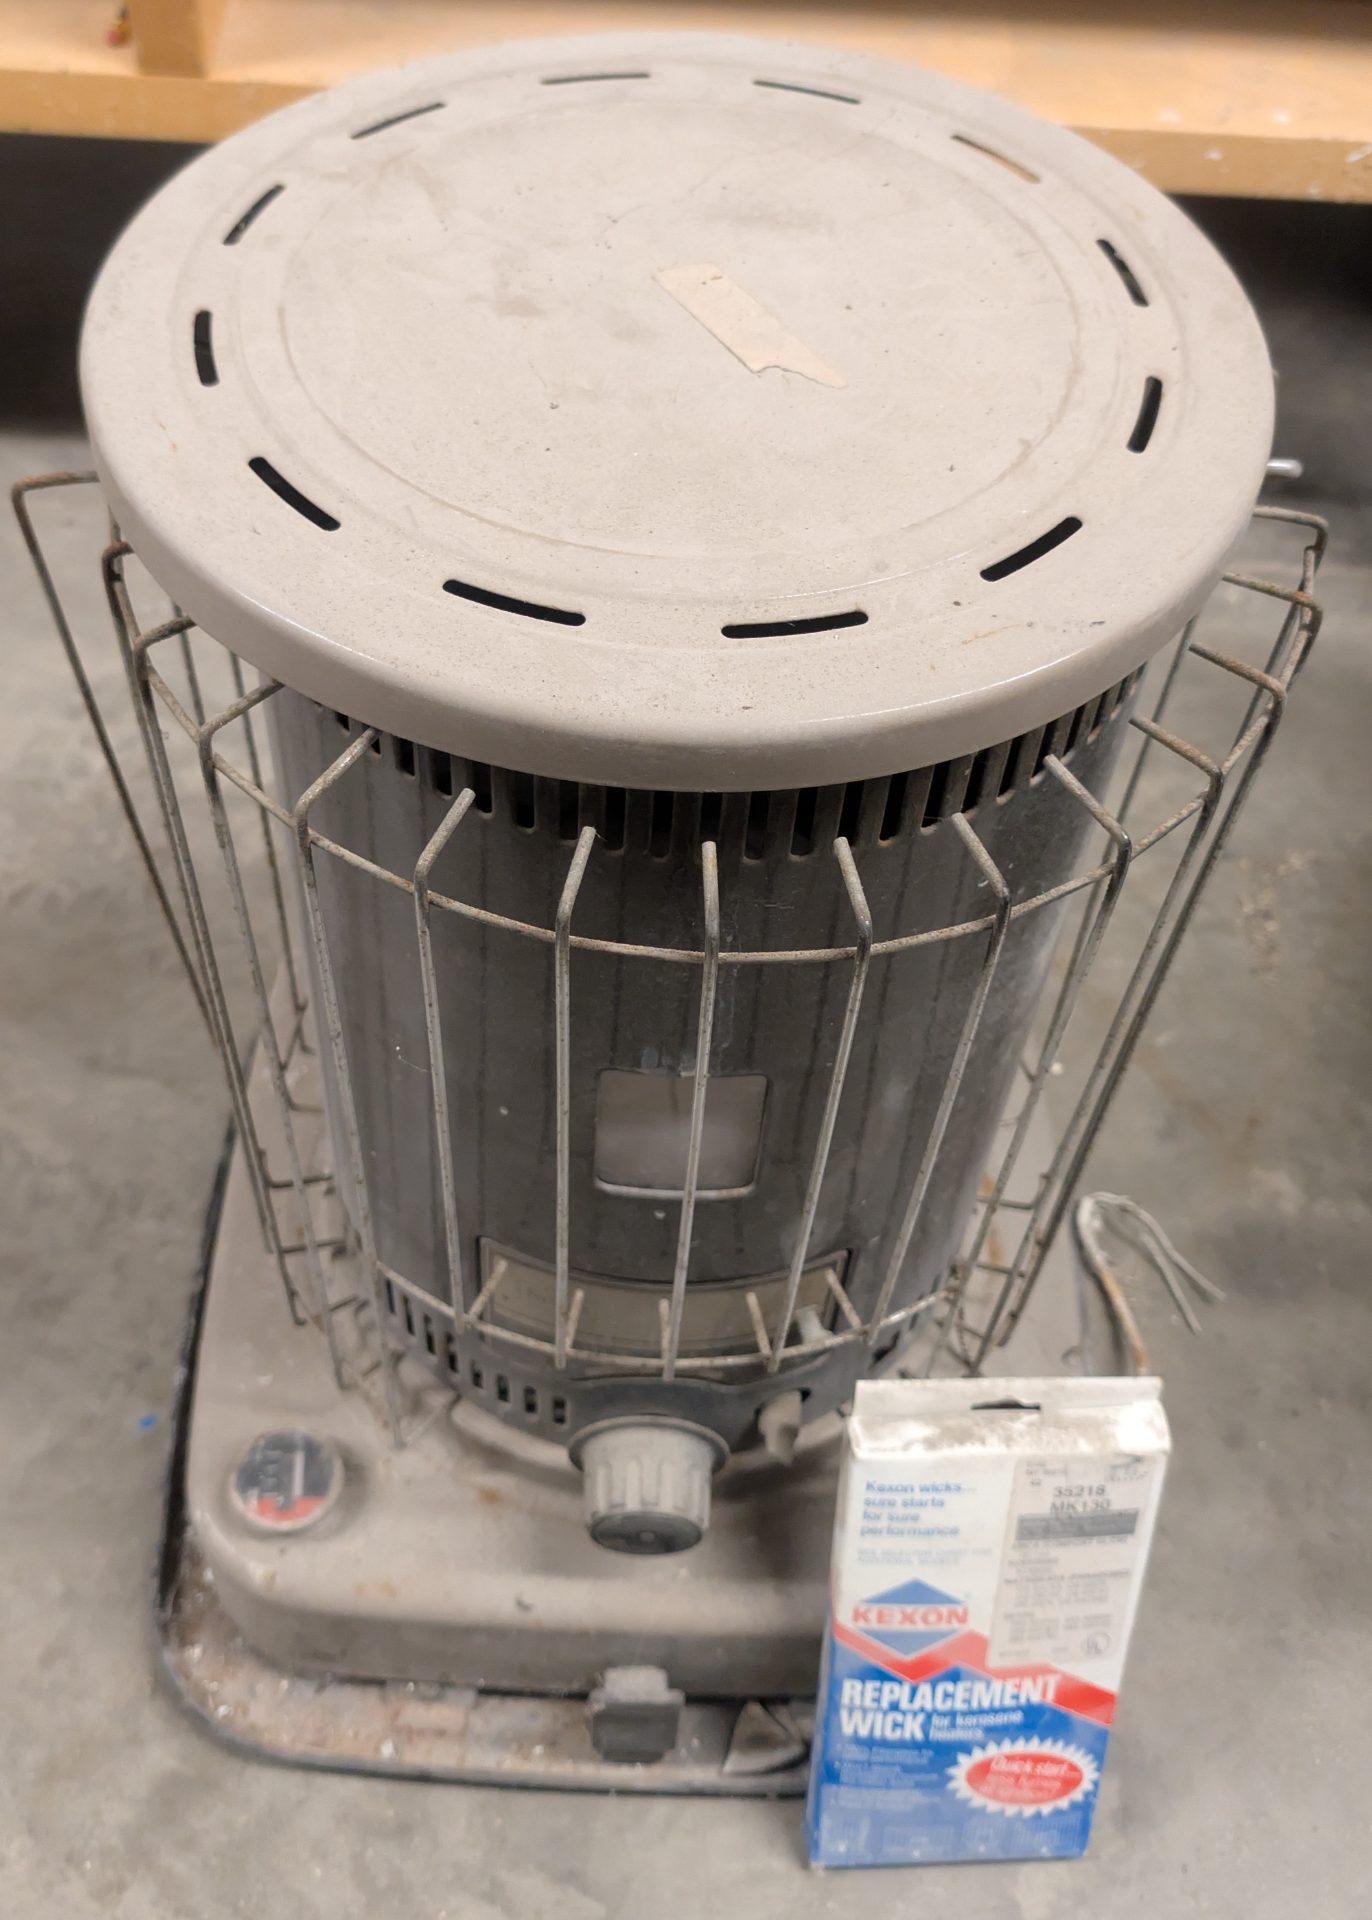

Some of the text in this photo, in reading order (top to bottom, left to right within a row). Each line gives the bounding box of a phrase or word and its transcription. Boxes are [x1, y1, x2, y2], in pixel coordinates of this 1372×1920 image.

[852, 1606, 969, 1626] KEXON
[841, 1674, 1061, 1711] REPLACEMENT
[840, 1709, 926, 1741] WICK
